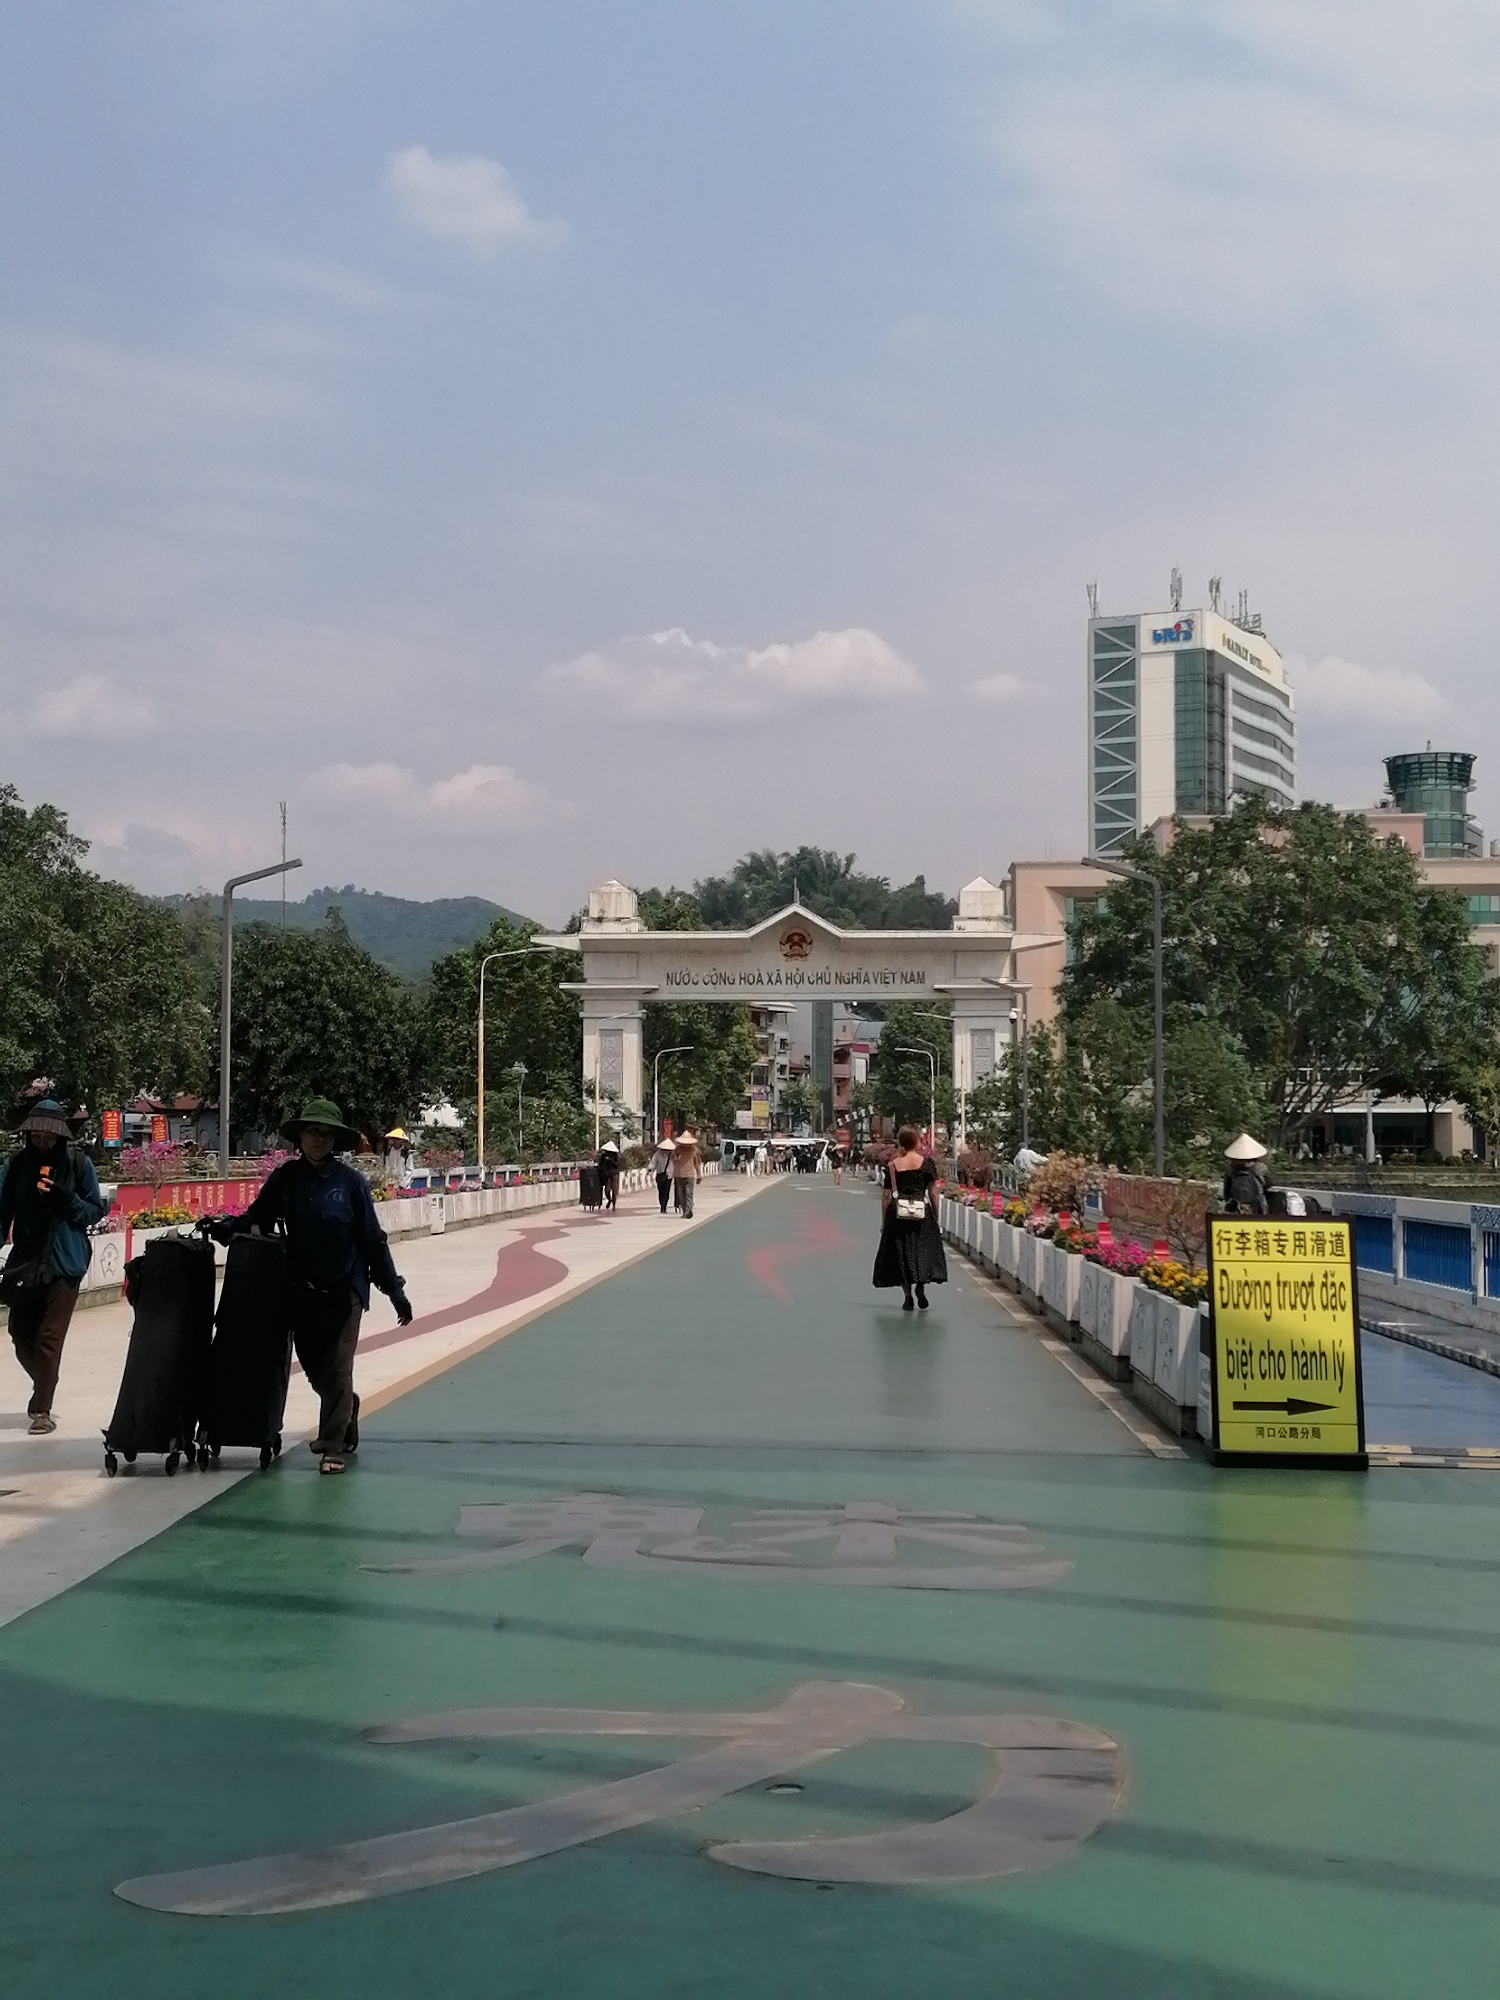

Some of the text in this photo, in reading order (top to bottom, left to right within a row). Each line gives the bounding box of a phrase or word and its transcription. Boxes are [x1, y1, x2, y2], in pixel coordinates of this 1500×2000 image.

[666, 965, 926, 989] NƯỚC CỘNG HOÀ XÃ HỘI CHỦ NGHĨA VIỆT NAM
[1216, 1229, 1346, 1257] 行李箱专用滑道
[1219, 1268, 1347, 1322] Đường trượt đặc
[1226, 1338, 1346, 1393] biệt cho hành lý
[1255, 1426, 1322, 1440] 河口公路分局
